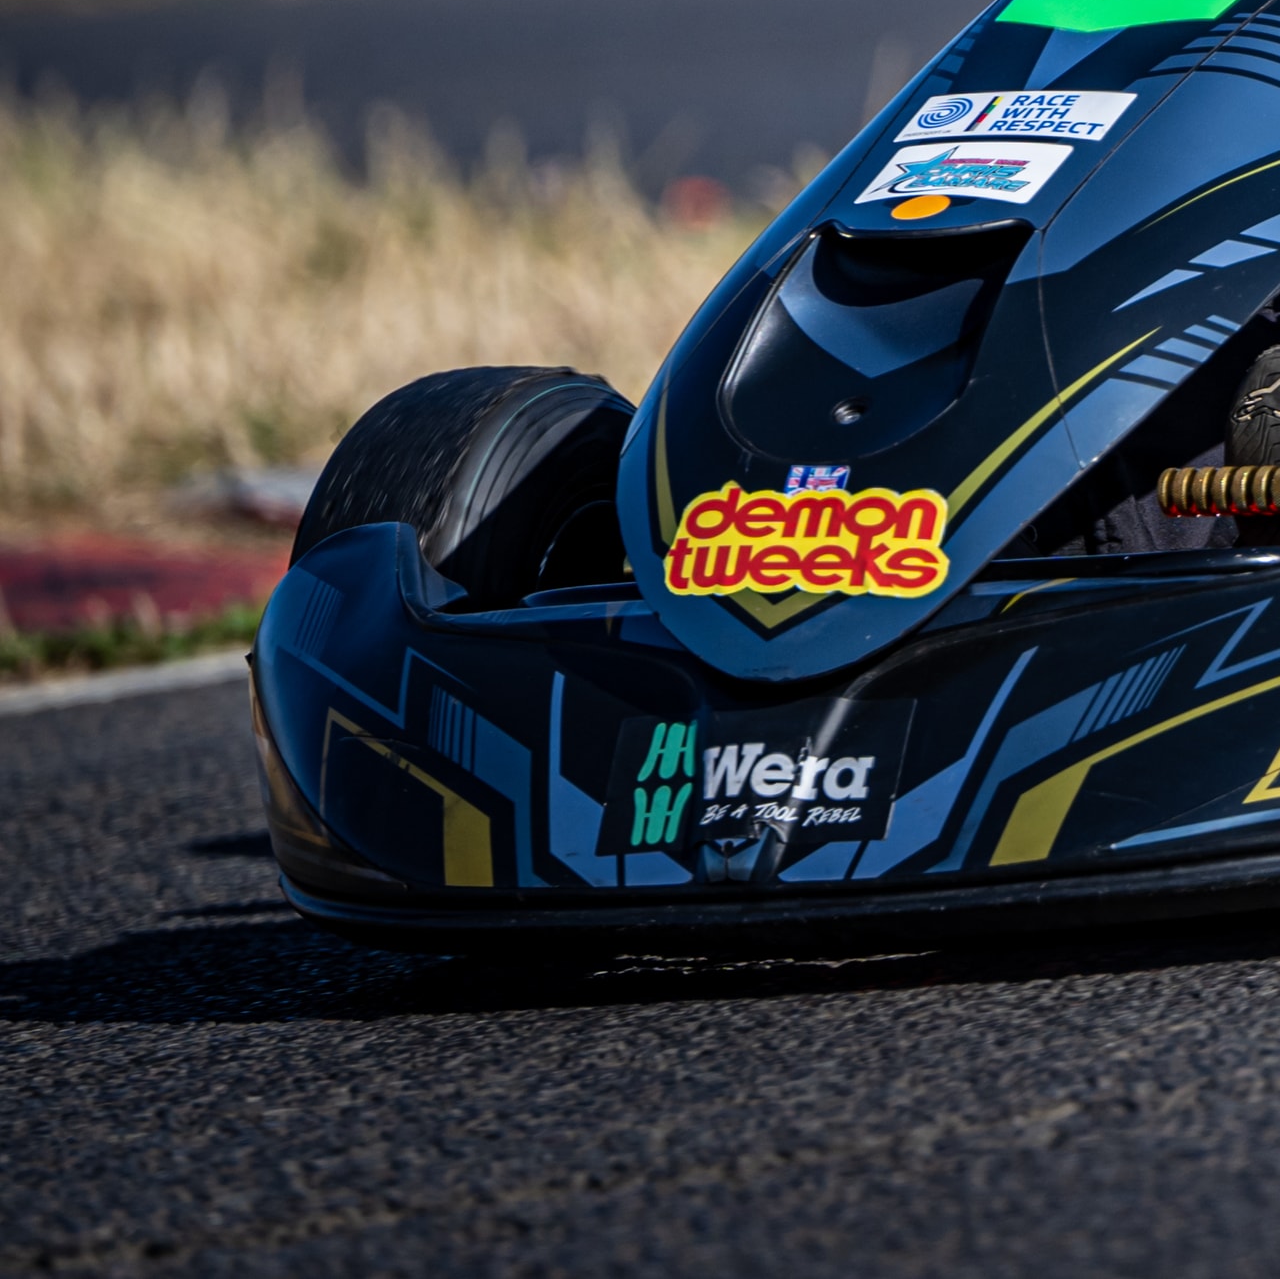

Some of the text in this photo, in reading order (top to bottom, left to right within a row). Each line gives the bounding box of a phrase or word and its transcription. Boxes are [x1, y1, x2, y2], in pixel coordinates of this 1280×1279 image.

[1001, 107, 1071, 119] WITH
[1010, 95, 1081, 106] RACE
[988, 120, 1105, 136] RESPECT
[685, 488, 939, 541] demon
[667, 536, 940, 590] tweeks
[702, 742, 876, 800] Wera
[700, 801, 863, 827] BE A TOOL REBEL
